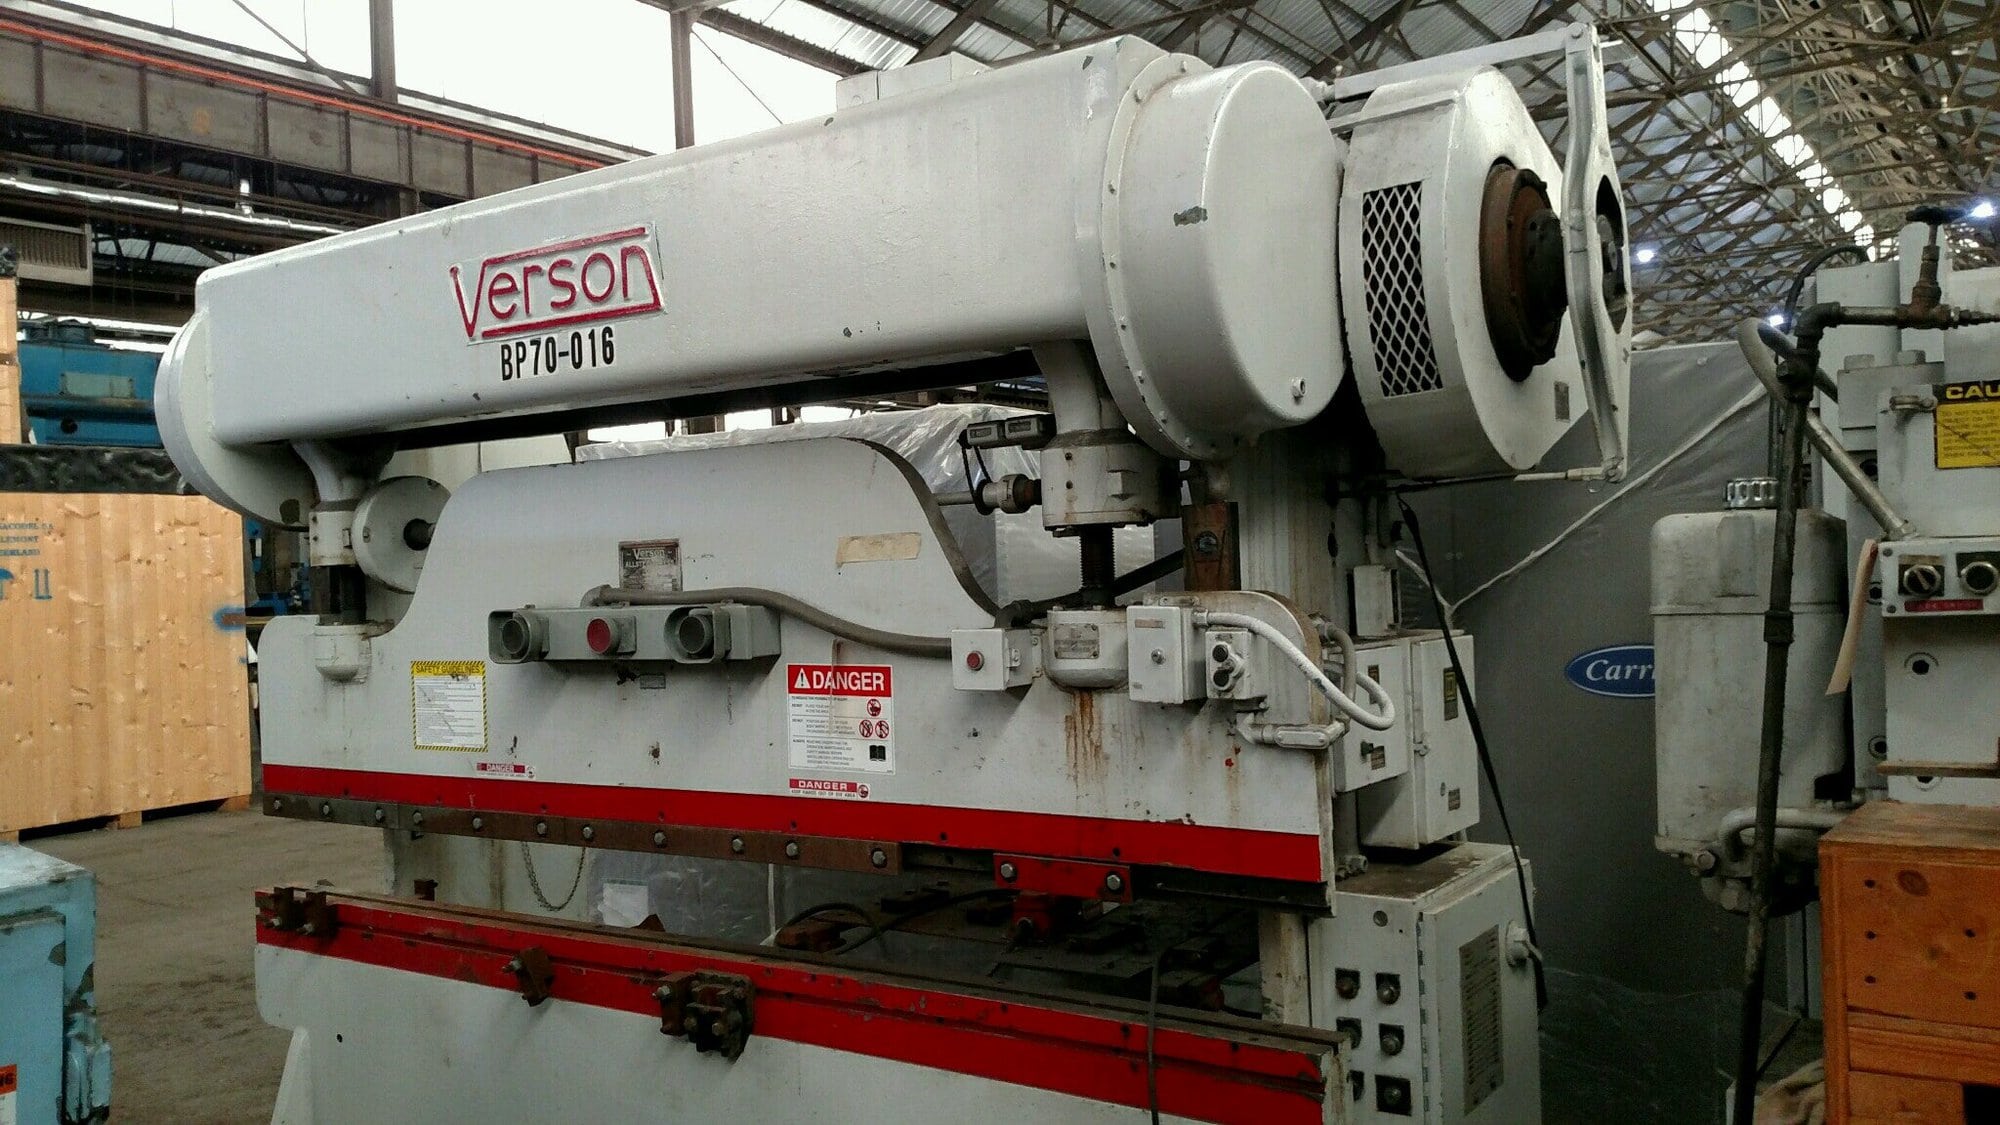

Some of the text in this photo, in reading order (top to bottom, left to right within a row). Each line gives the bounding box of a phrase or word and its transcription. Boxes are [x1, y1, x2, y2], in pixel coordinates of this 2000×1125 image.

[450, 236, 661, 338] Verson
[501, 326, 614, 381] BP70-016
[632, 548, 665, 560] Verson
[415, 665, 481, 674] SAFETY GUIDELINES
[812, 670, 885, 691] DANGER
[486, 763, 514, 772] DANGER
[798, 780, 848, 791] DANGER
